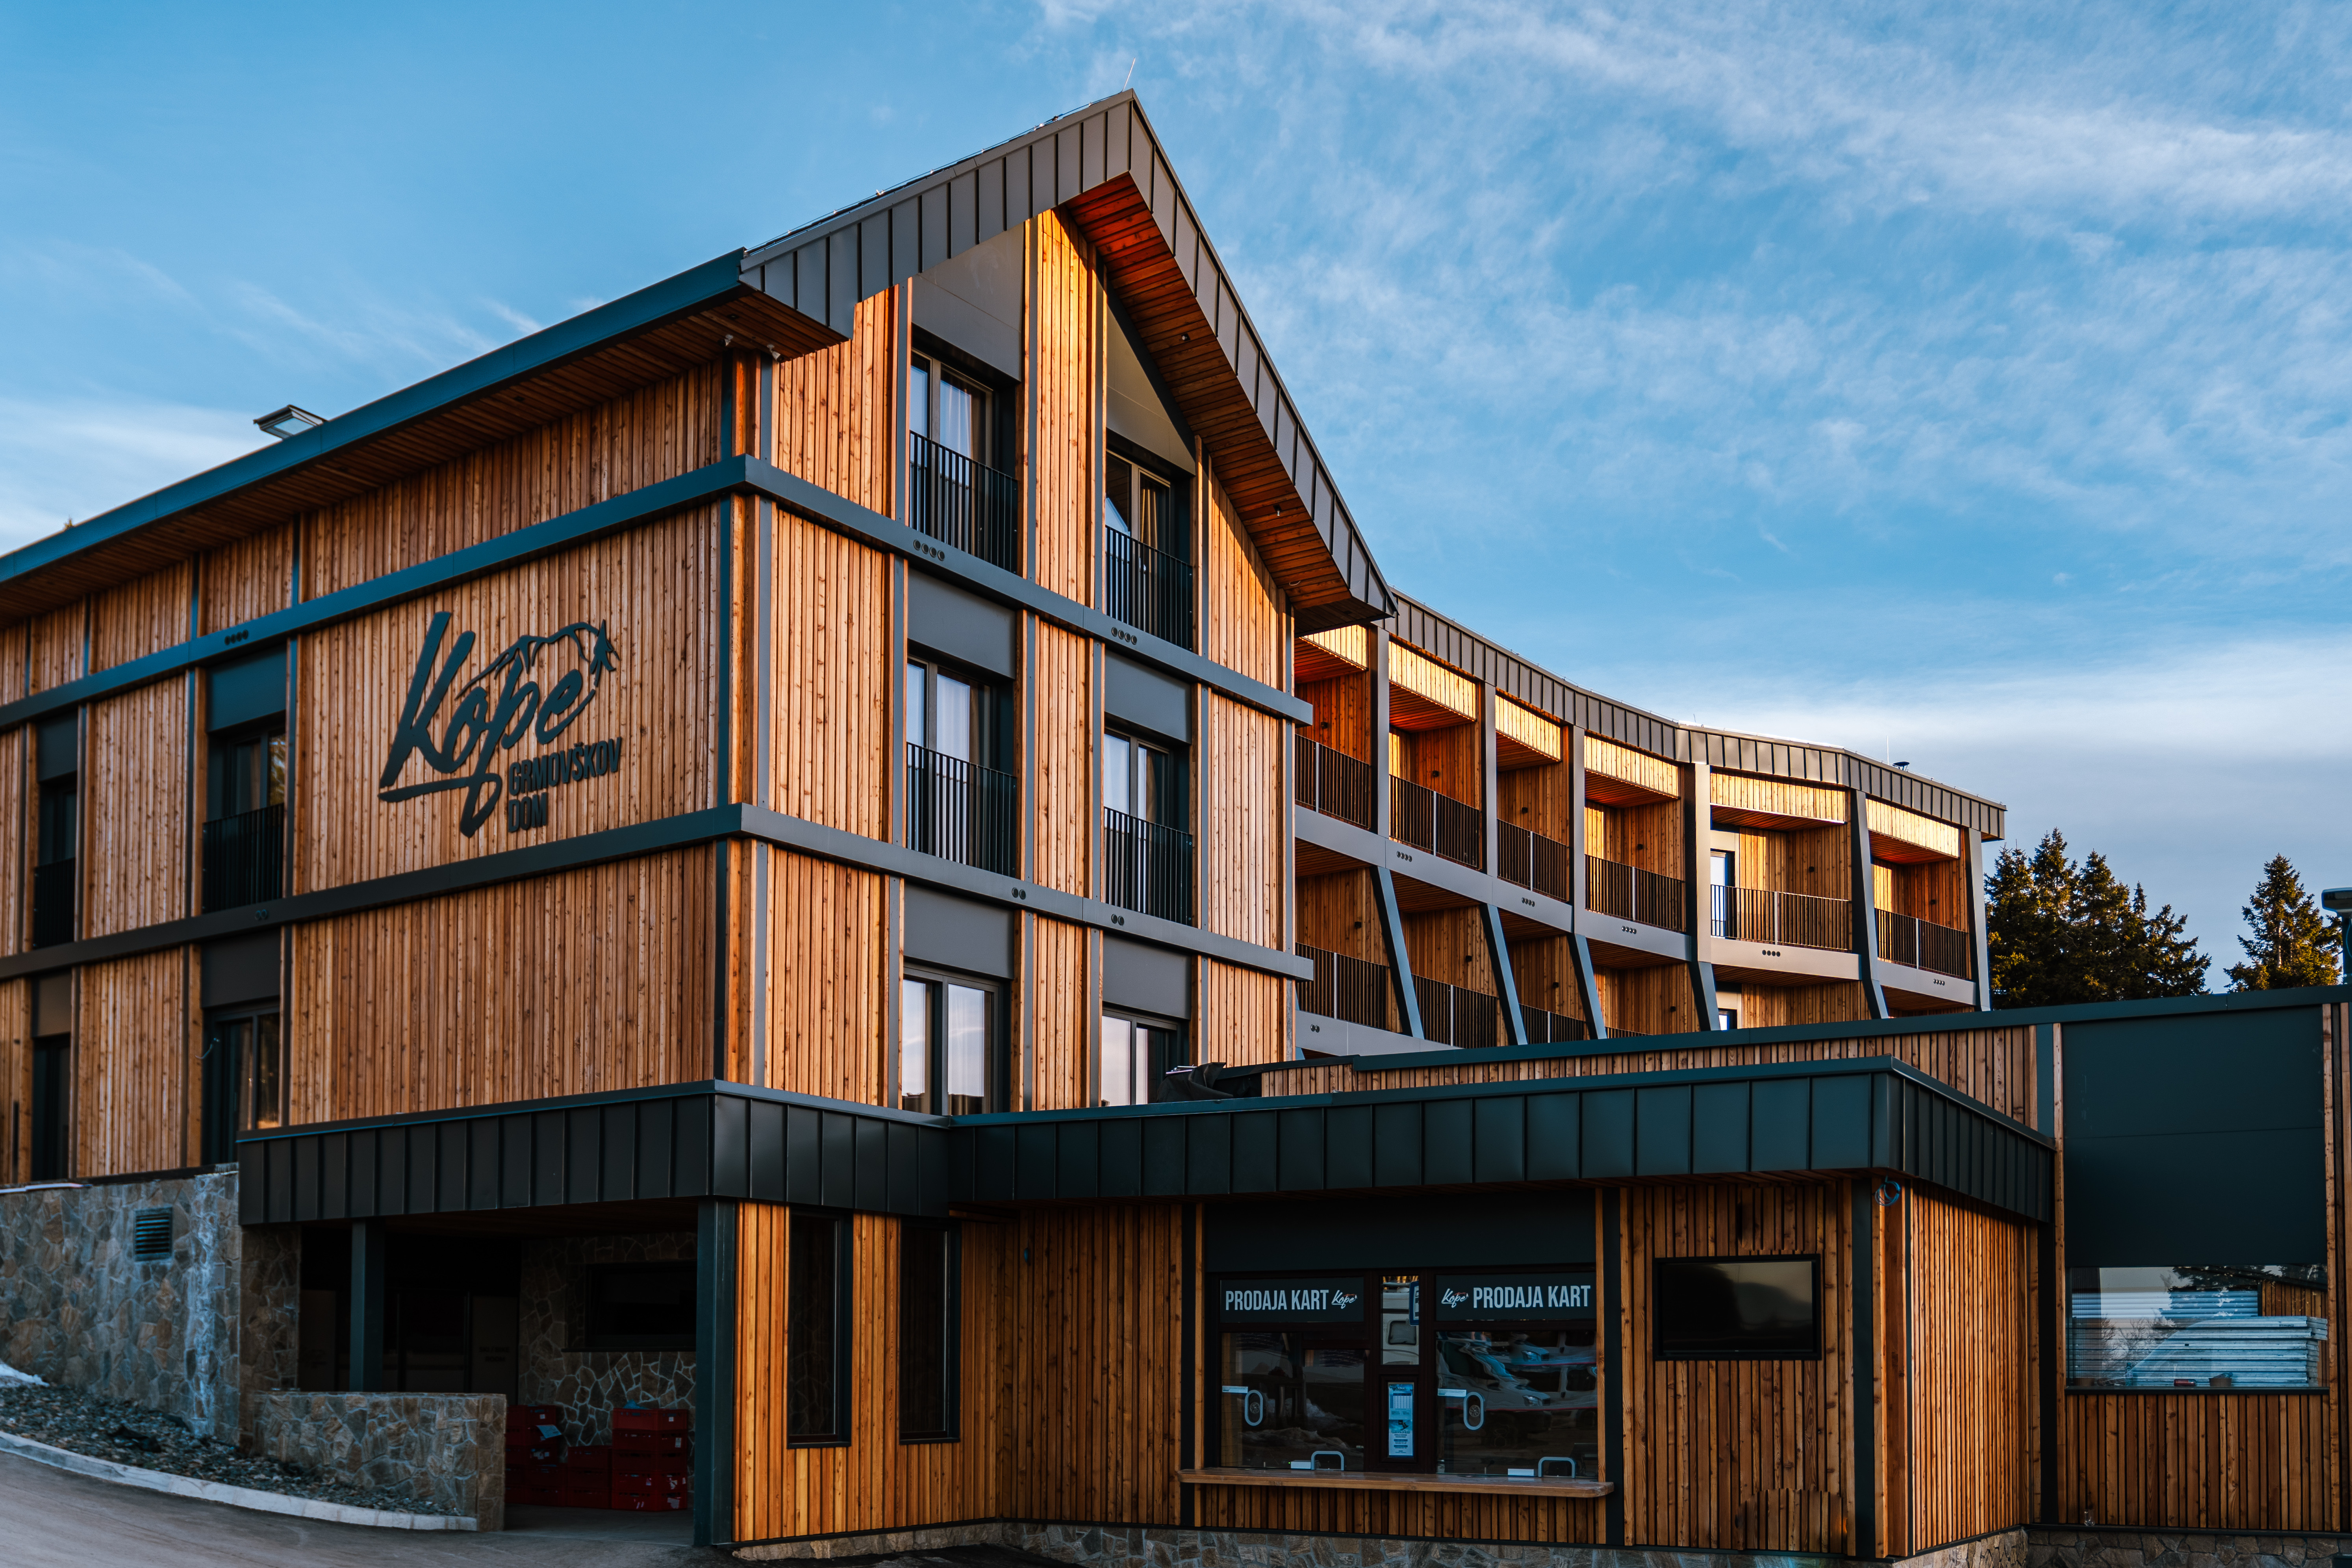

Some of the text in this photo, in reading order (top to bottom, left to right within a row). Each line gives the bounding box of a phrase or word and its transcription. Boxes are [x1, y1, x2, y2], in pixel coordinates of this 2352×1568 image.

[377, 611, 596, 838] Kope
[508, 737, 622, 796] GRMOVŠKOV
[508, 791, 548, 833] DOM
[1225, 1289, 1357, 1310] PRODAJA KART Kope
[1441, 1285, 1591, 1308] Kope PRODAJA KART
